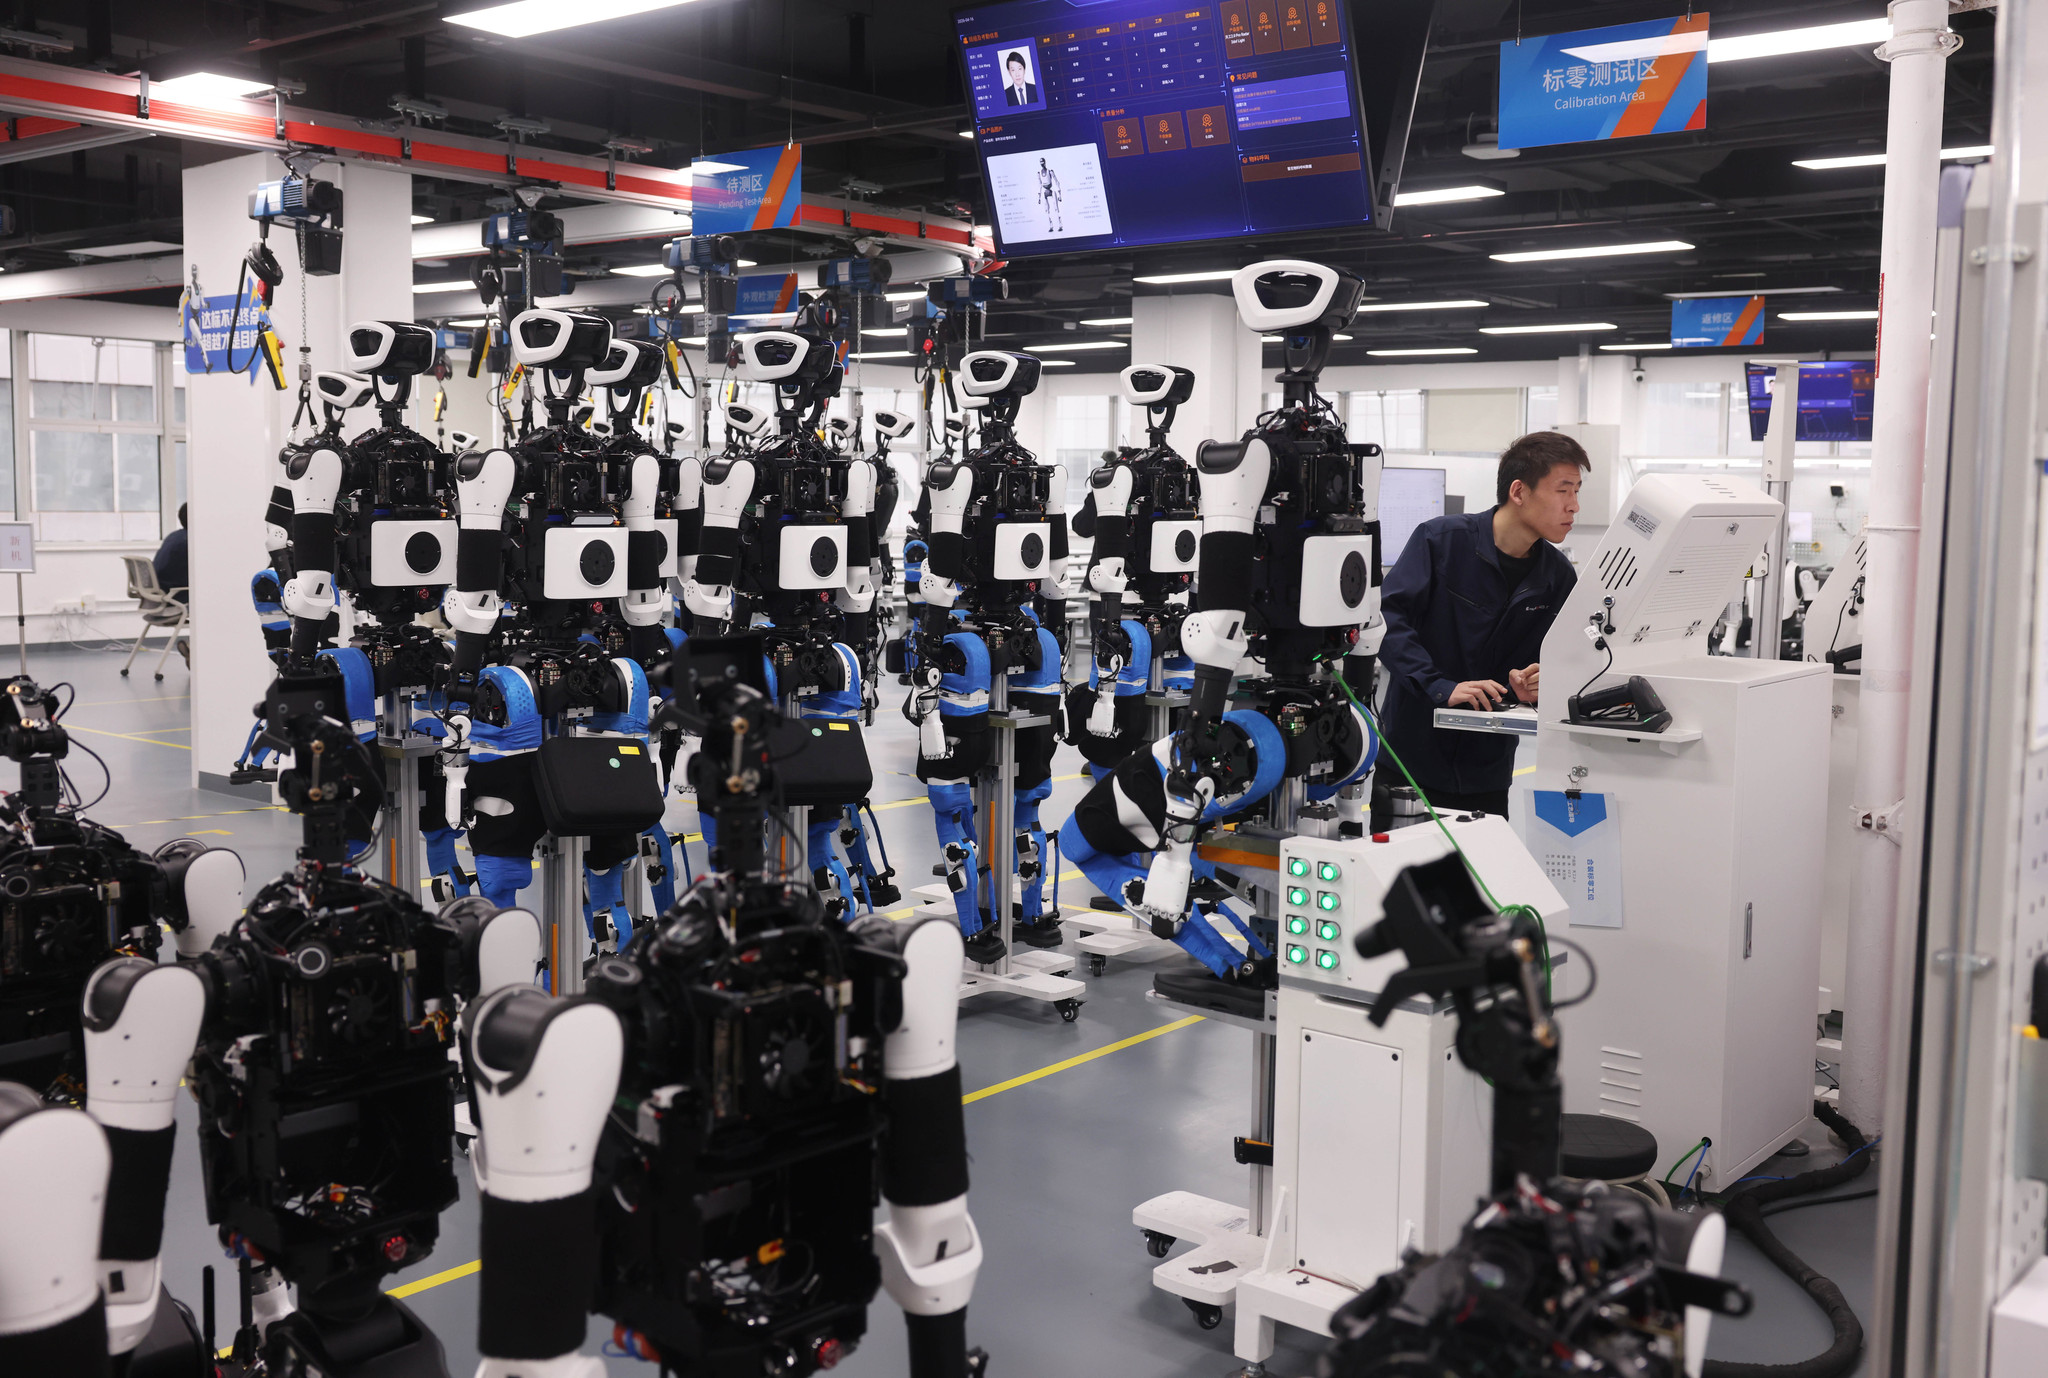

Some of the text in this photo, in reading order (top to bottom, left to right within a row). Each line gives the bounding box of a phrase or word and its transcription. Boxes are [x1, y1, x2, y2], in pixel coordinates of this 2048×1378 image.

[1543, 56, 1659, 93] 标零测试区
[1555, 90, 1646, 110] Calibration Area
[727, 174, 763, 194] 待测区
[719, 196, 772, 209] Pending Test Area
[743, 290, 782, 303] 外观检测区
